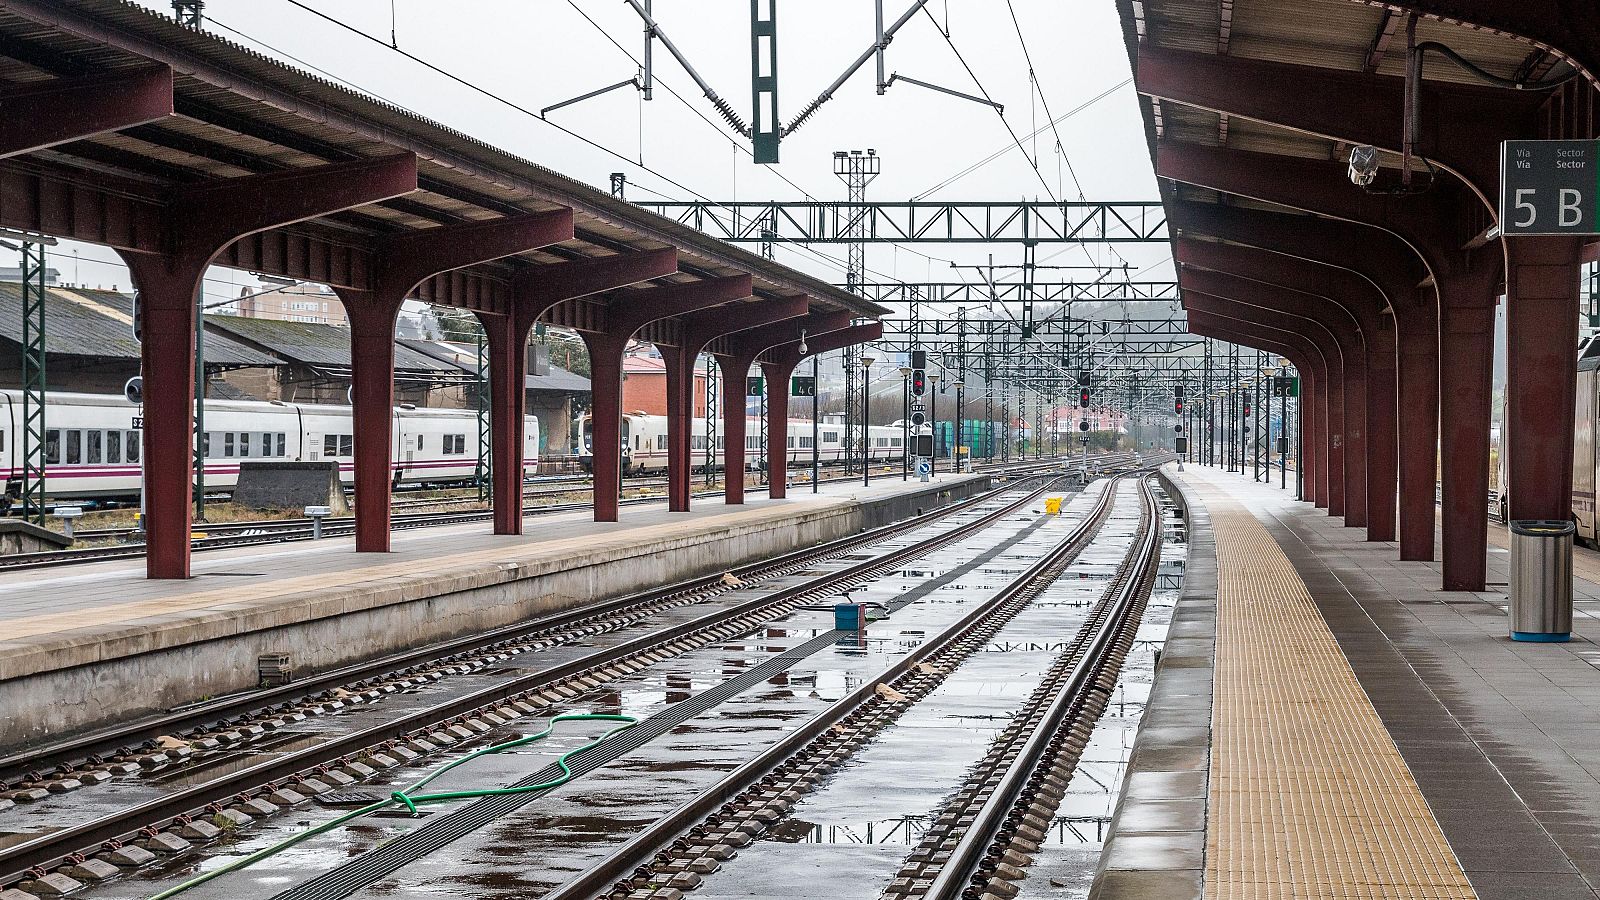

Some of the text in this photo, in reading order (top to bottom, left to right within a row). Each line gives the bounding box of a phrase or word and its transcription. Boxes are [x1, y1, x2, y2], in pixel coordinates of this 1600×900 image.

[1516, 148, 1585, 158] Vía Sector
[1516, 160, 1586, 169] Vía Sector
[1514, 188, 1583, 228] 5 B
[751, 386, 757, 395] C
[798, 386, 813, 395] 4 C
[1276, 386, 1291, 396] 5 C
